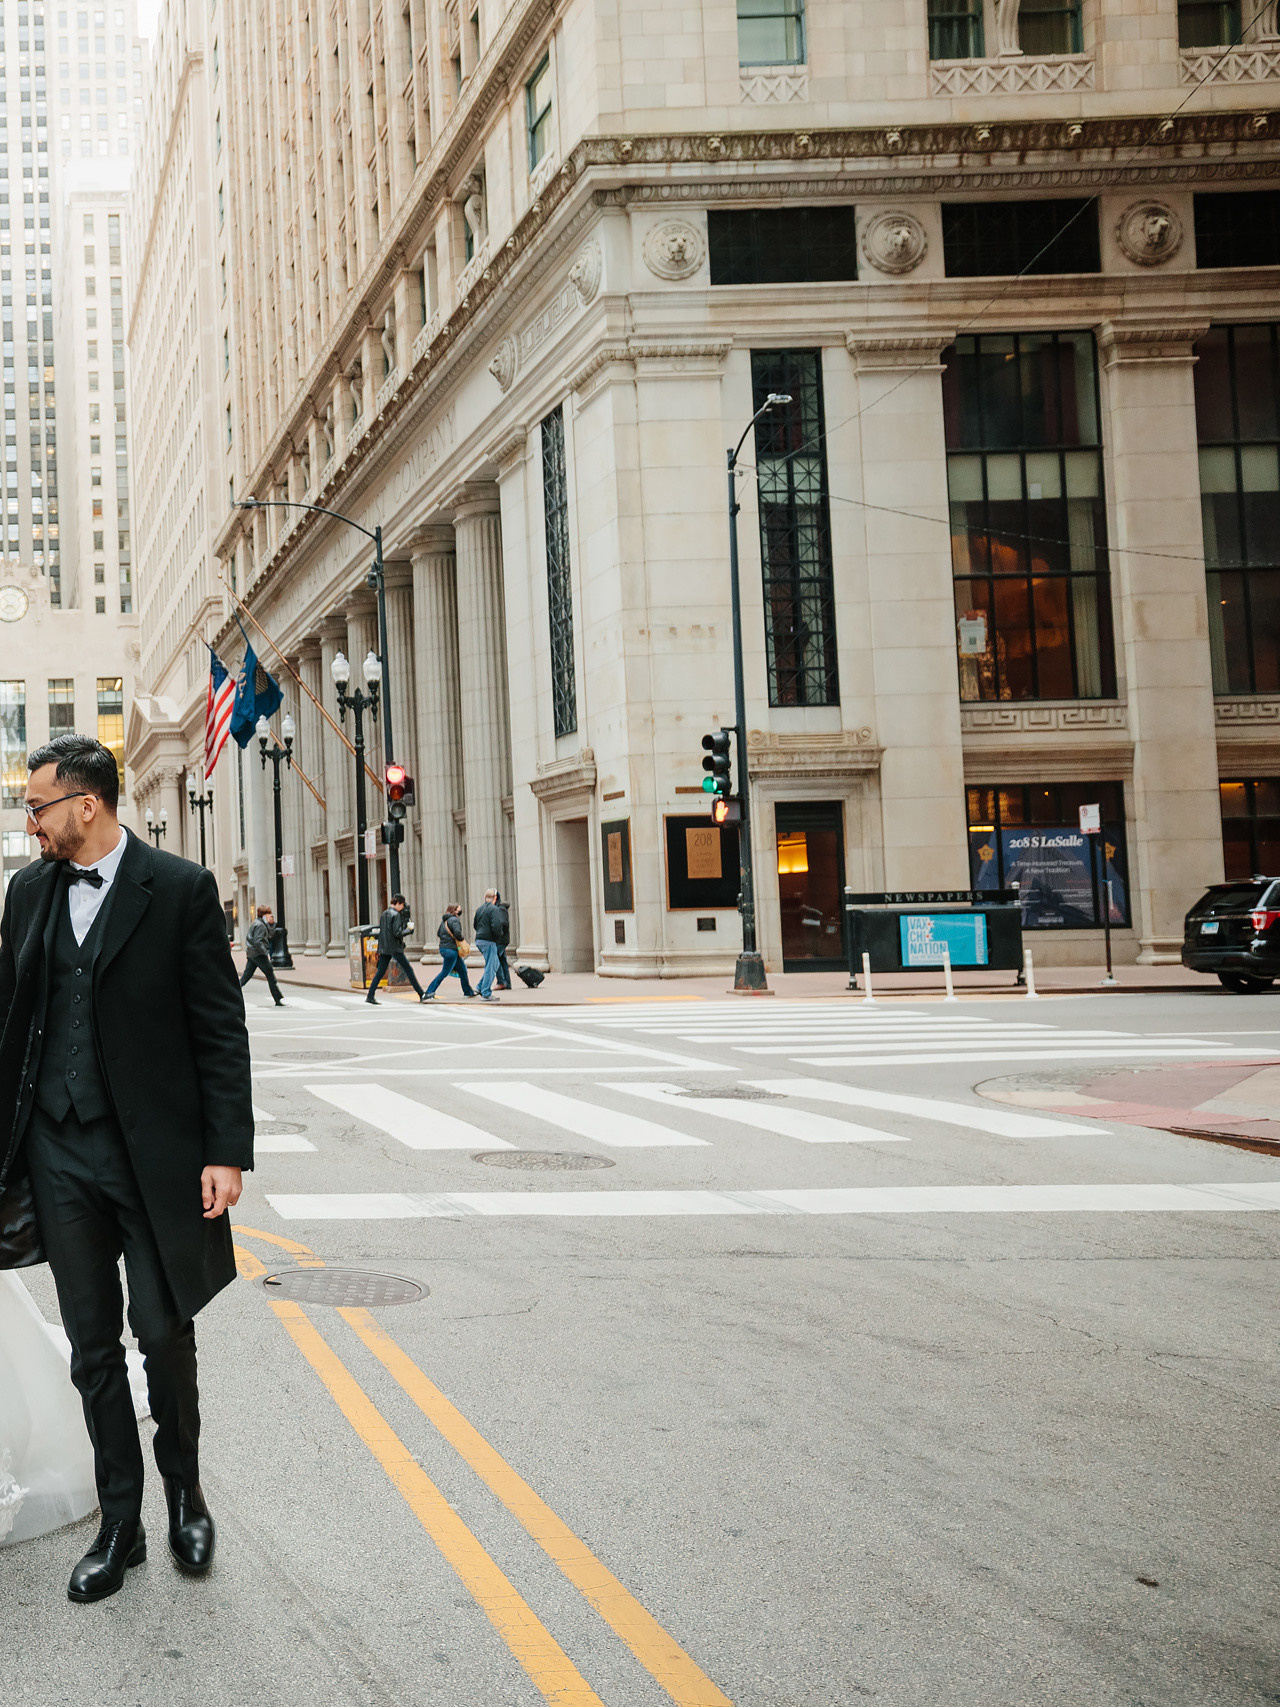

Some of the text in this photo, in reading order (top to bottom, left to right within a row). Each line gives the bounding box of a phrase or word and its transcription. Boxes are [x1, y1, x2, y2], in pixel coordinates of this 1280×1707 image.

[694, 833, 713, 846] 208
[1010, 835, 1083, 848] 208 S LaSalle
[884, 891, 984, 903] NEWSPAPERS
[910, 942, 947, 955] NATION
